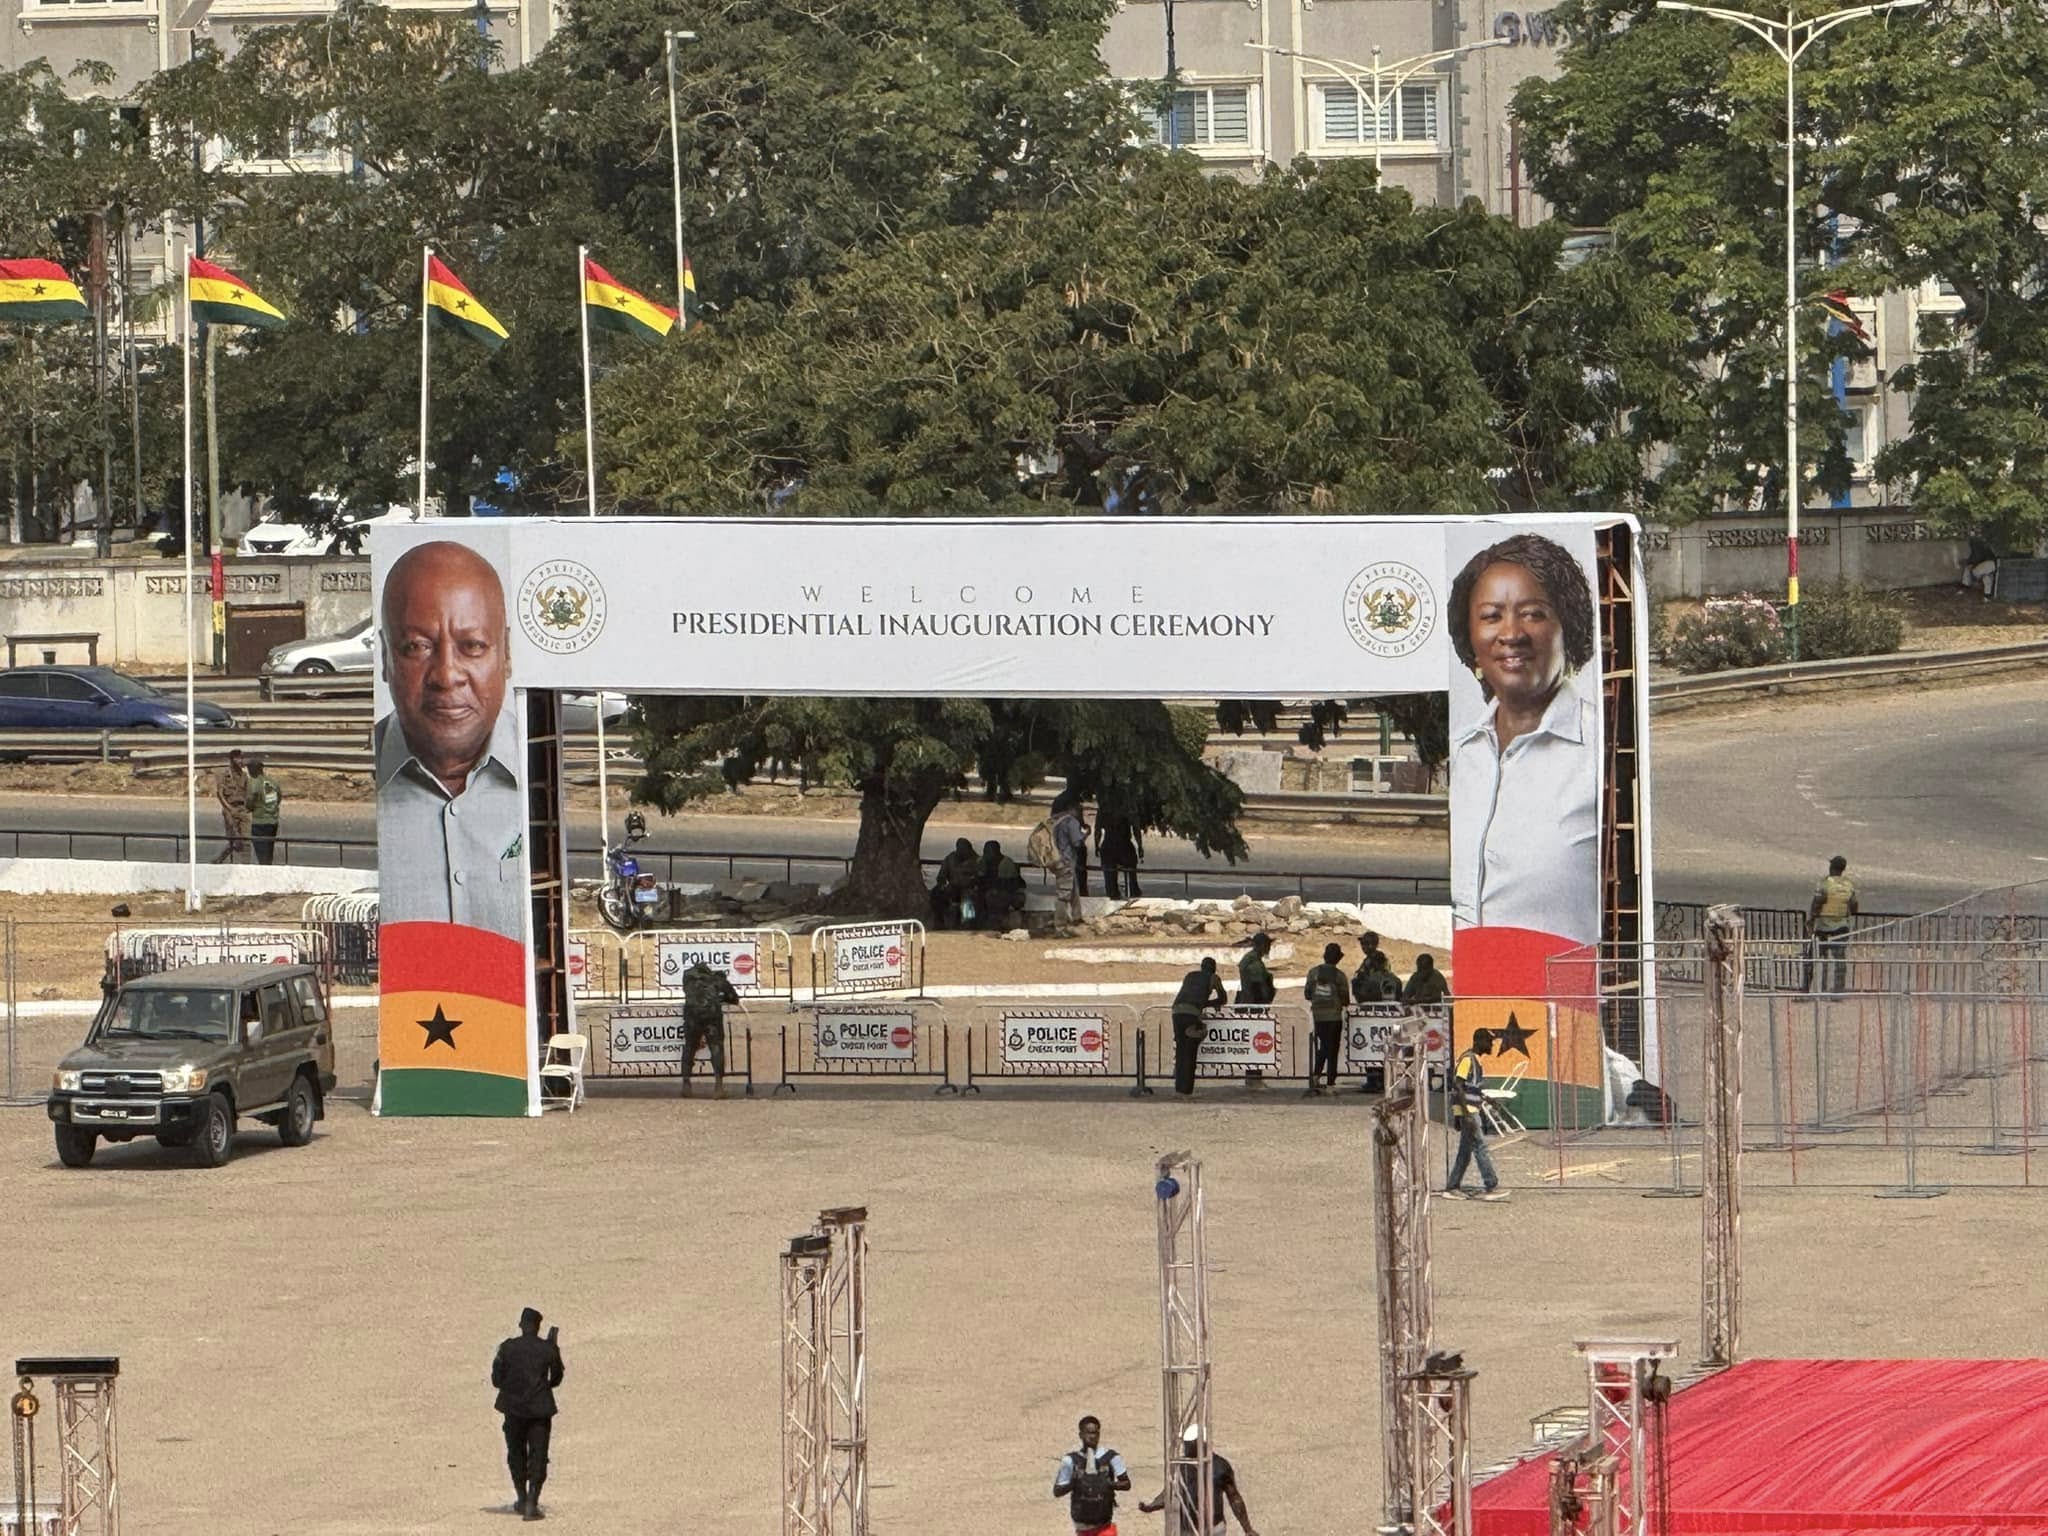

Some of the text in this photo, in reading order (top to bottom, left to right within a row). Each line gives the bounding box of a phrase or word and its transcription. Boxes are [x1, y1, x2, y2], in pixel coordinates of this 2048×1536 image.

[800, 585, 1144, 604] WELCOME
[672, 612, 1276, 637] PRESIDENTIAL INAUGURATION CEREMONY
[852, 944, 885, 961] POLICE
[633, 1025, 685, 1041] POLICE
[840, 1023, 888, 1039] POLICE
[1027, 1027, 1077, 1041] POLICE
[1209, 1028, 1250, 1042] OLICE
